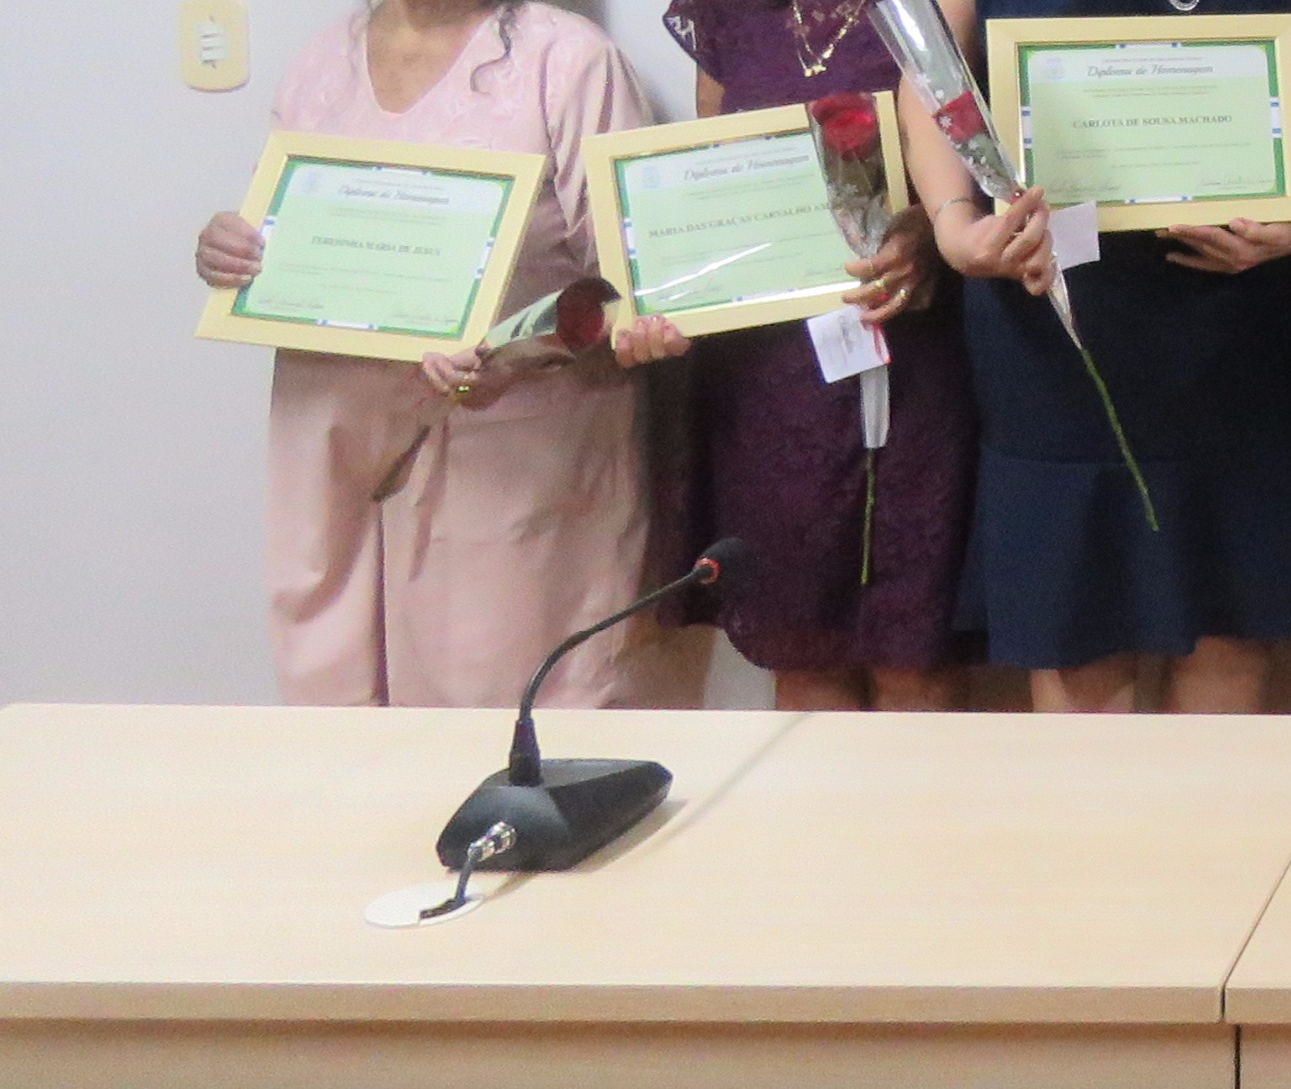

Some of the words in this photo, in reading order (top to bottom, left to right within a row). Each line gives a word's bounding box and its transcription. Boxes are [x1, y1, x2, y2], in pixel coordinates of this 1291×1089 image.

[1126, 118, 1139, 127] DE
[1178, 115, 1233, 125] MACHADO
[649, 226, 684, 239] MARIA
[685, 222, 708, 233] DAS
